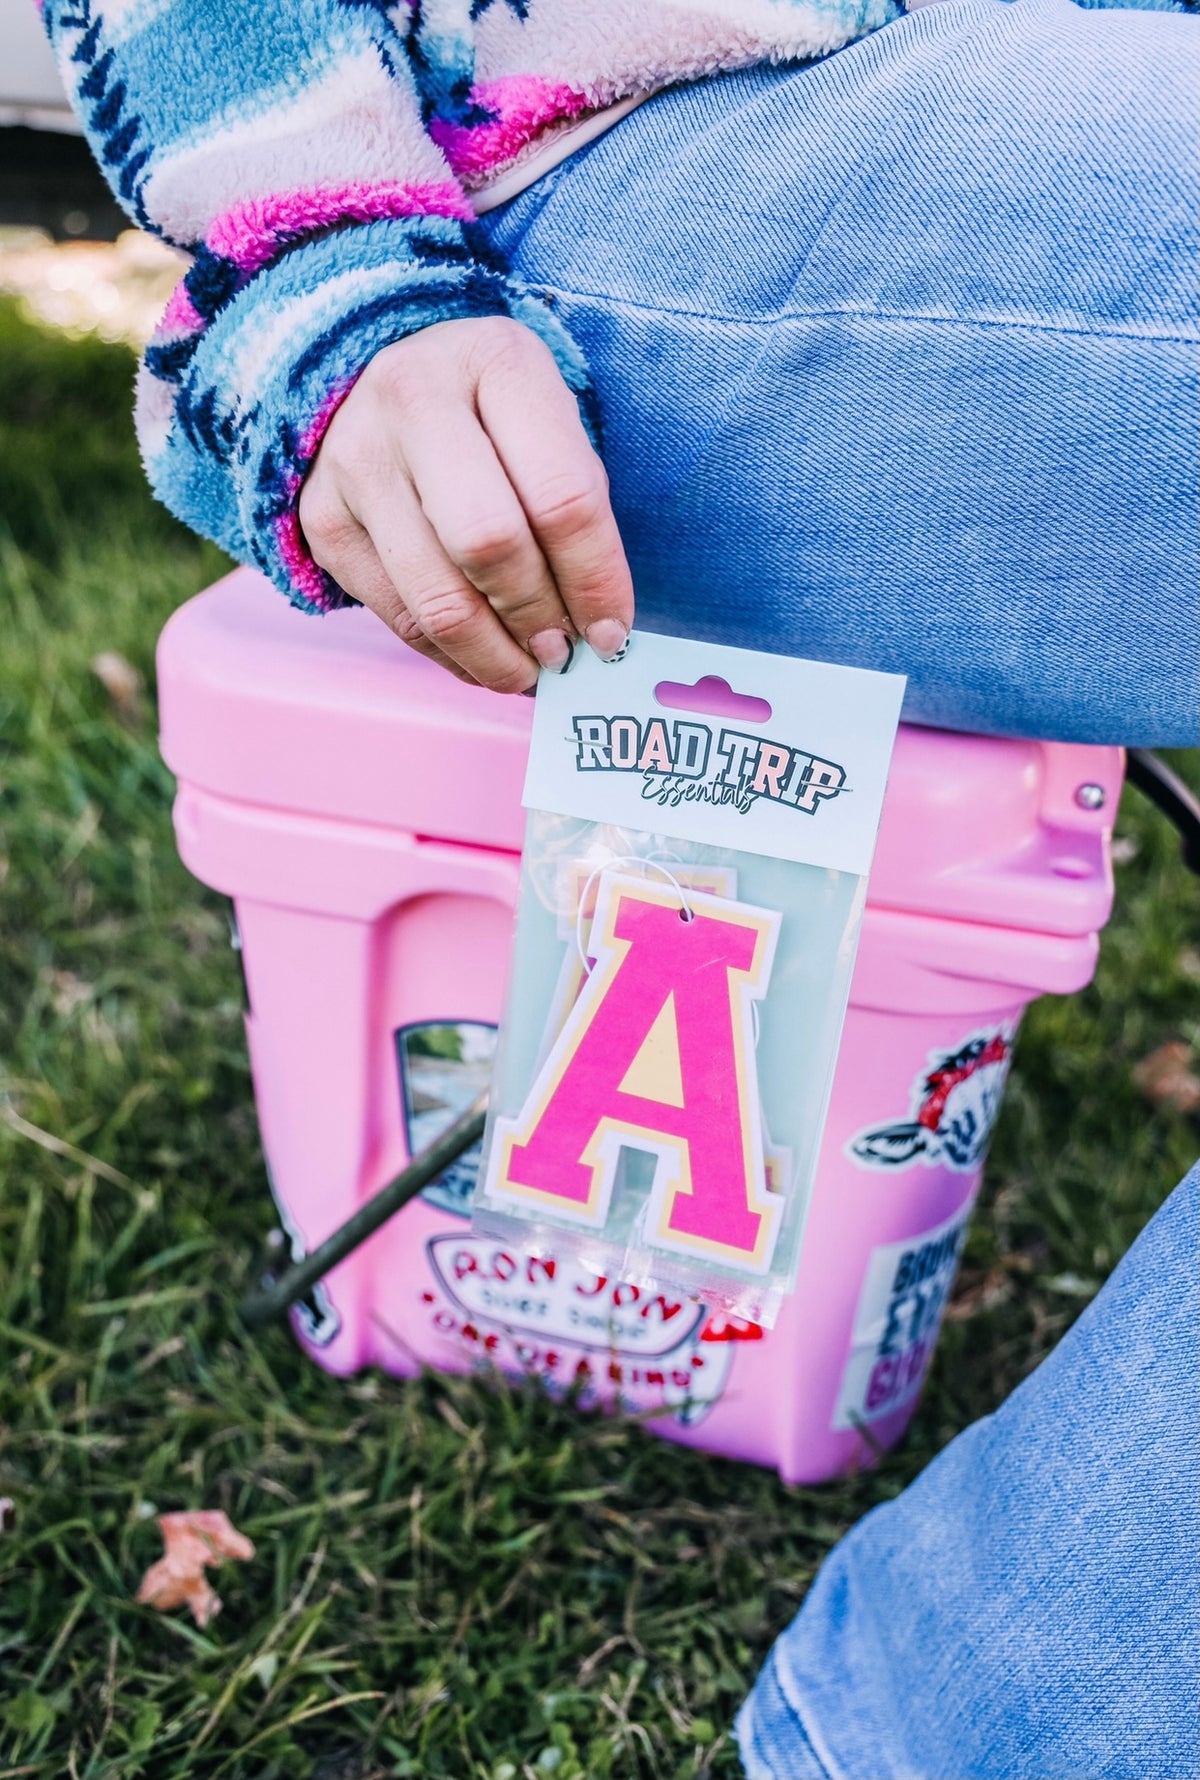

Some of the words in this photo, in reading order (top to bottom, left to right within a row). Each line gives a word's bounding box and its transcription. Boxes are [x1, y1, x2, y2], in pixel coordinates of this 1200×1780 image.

[572, 715, 712, 780] ROAD
[717, 728, 847, 816] TRIP
[641, 764, 761, 815] Essentials
[502, 885, 770, 1264] A
